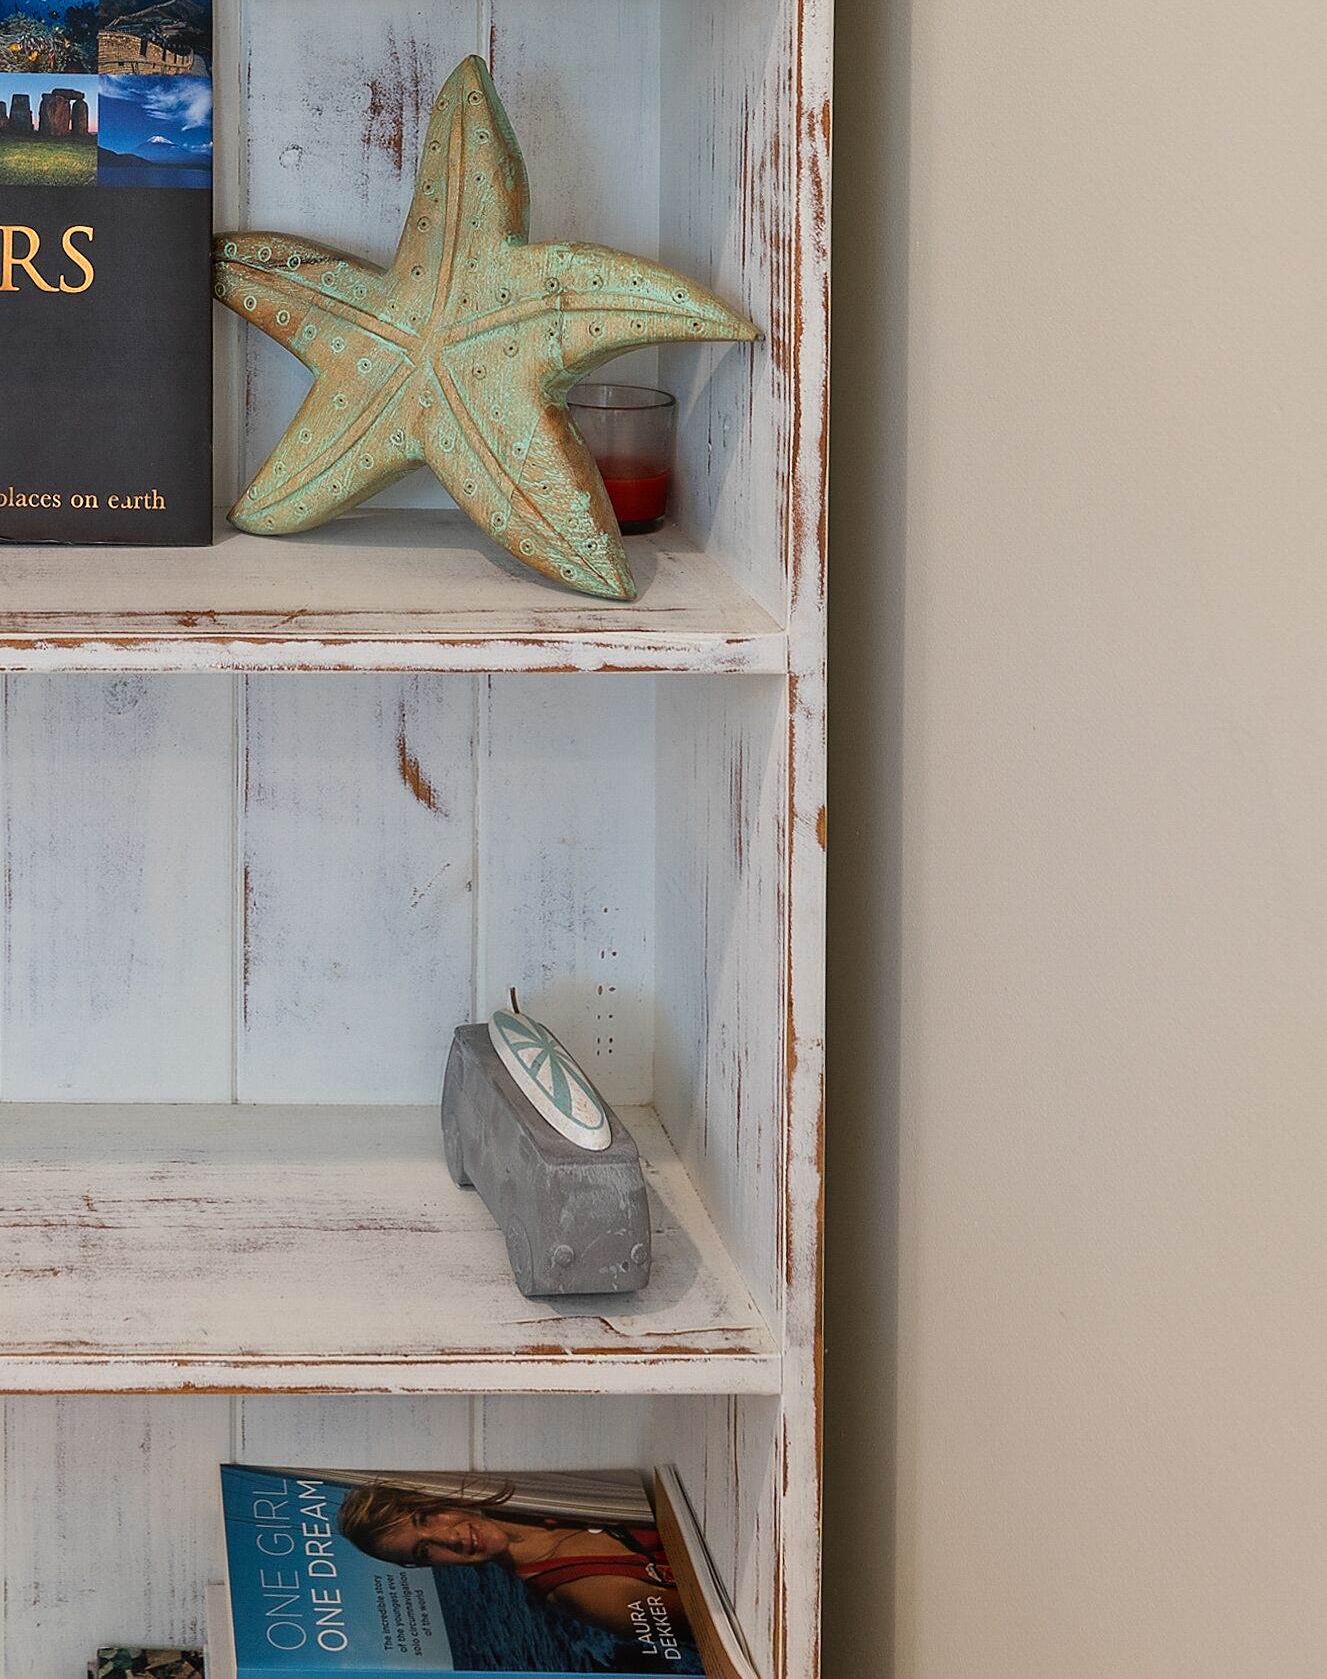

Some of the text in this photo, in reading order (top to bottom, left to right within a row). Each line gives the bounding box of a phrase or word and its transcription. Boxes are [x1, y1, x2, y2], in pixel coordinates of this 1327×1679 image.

[70, 493, 100, 509] on
[107, 489, 167, 510] earth
[252, 1479, 307, 1650] ONE GIRL
[296, 1480, 349, 1652] ONE DREAM
[374, 1575, 394, 1651] The incredible story
[386, 1574, 408, 1653] of the youngest ever
[399, 1571, 423, 1656] solo circumnavigation
[414, 1589, 432, 1637] of the world
[627, 1600, 658, 1655] LAURA
[646, 1595, 682, 1660] DEKKER
